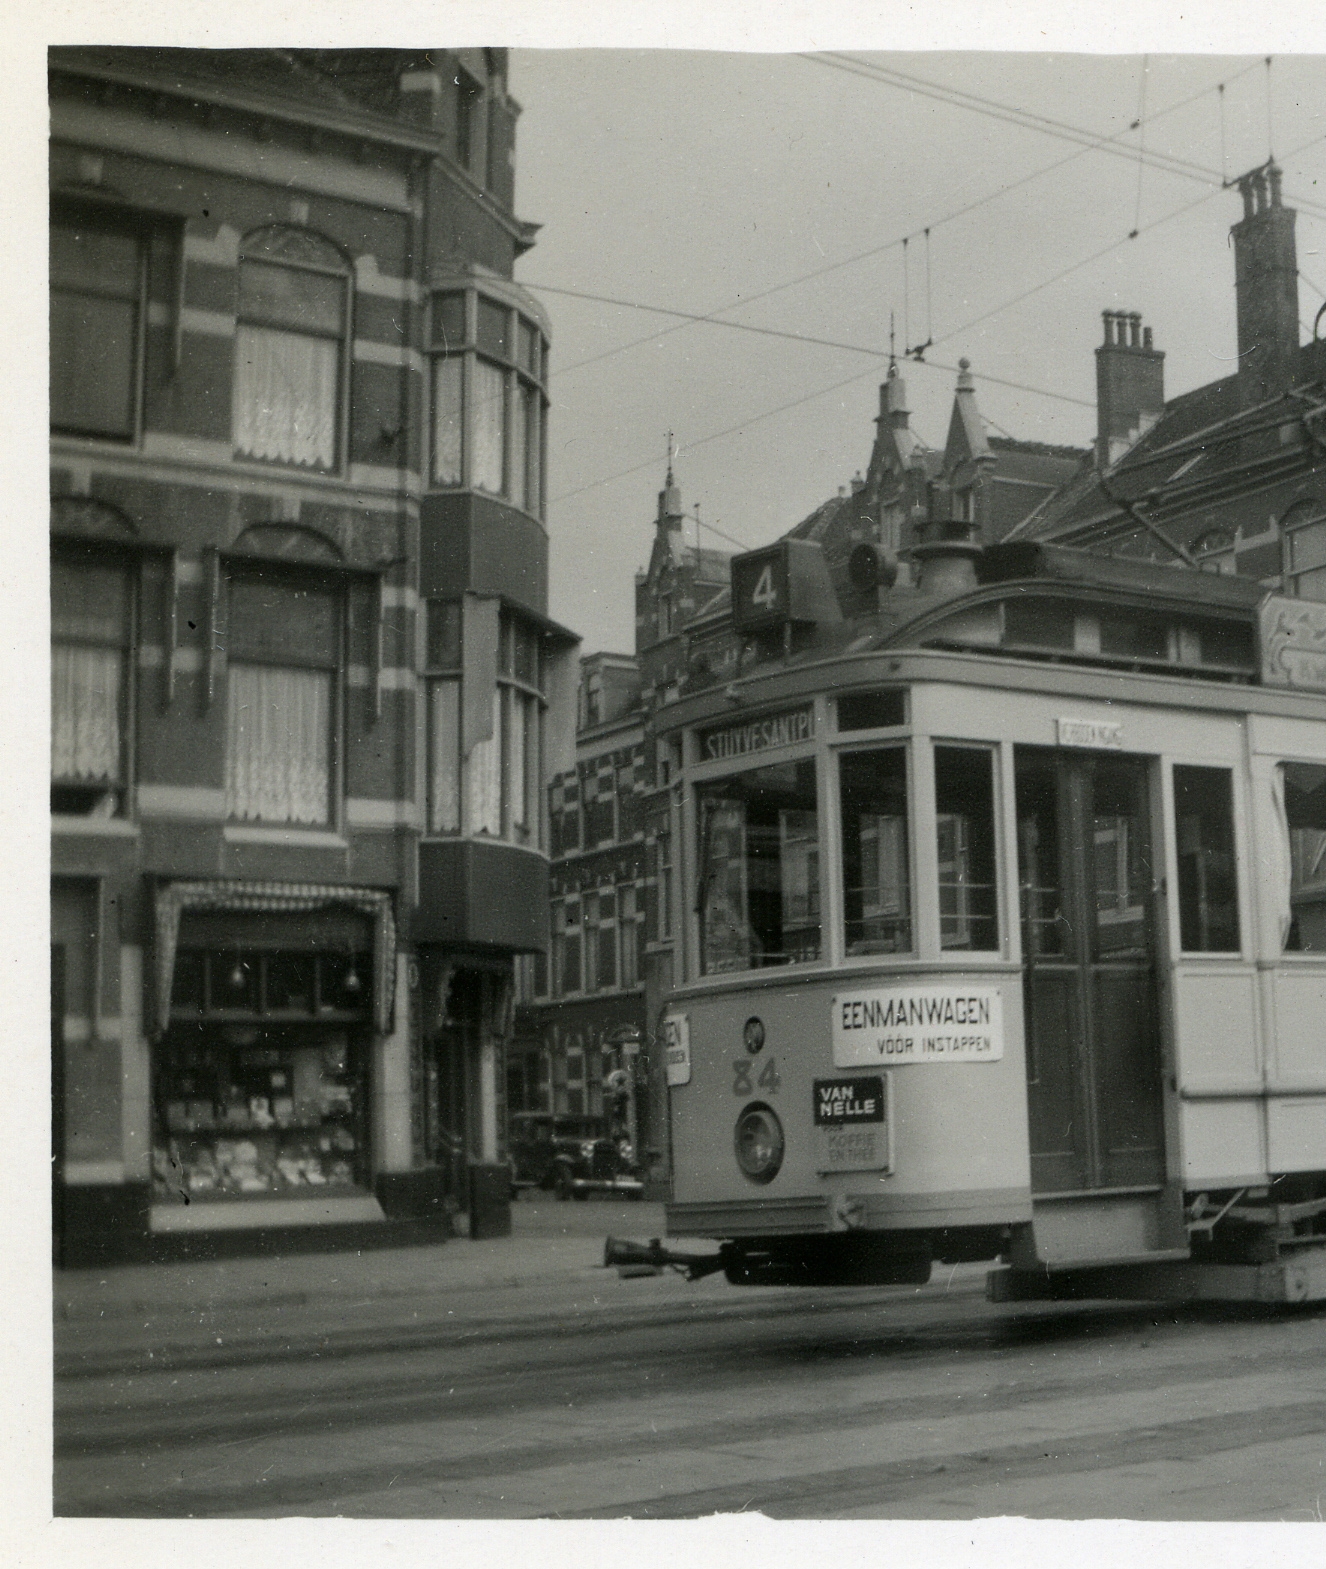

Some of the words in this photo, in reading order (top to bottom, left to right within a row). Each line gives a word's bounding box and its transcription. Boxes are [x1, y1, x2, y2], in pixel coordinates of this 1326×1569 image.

[752, 564, 778, 610] 4
[842, 997, 990, 1030] EENMANWAGEN
[922, 1035, 991, 1053] INSTAPPEN
[732, 1056, 782, 1097] 84
[820, 1086, 853, 1101] VAN
[820, 1099, 876, 1116] NELLE
